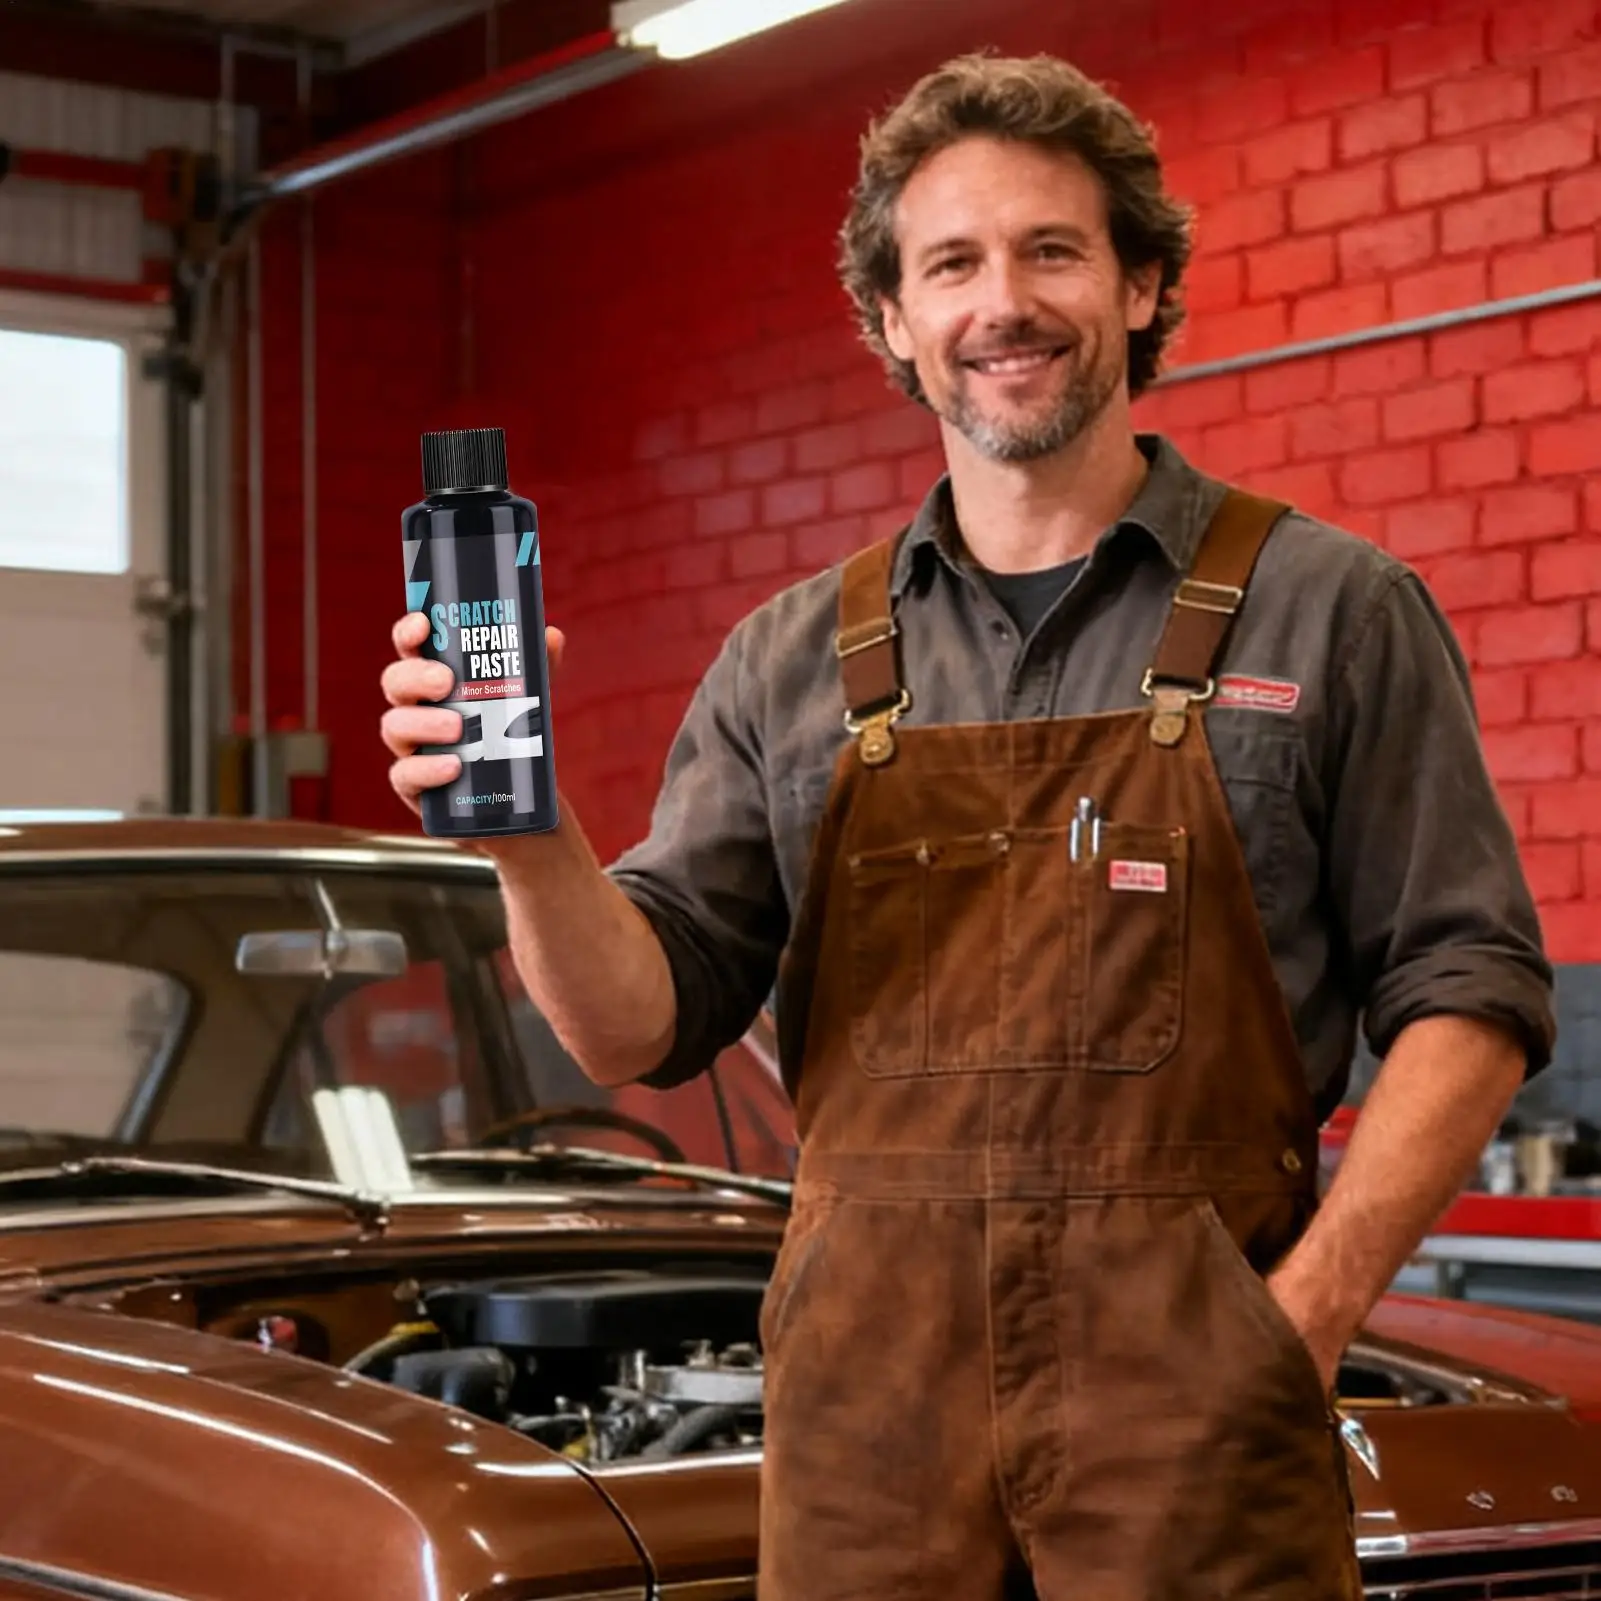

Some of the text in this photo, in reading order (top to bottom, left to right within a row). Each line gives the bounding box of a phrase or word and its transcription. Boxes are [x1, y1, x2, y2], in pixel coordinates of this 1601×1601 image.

[430, 598, 516, 652] SCRATCH
[460, 624, 519, 653] REPAIR
[470, 651, 521, 679] PASTE
[461, 686, 483, 697] Minor
[484, 683, 521, 695] Scratches
